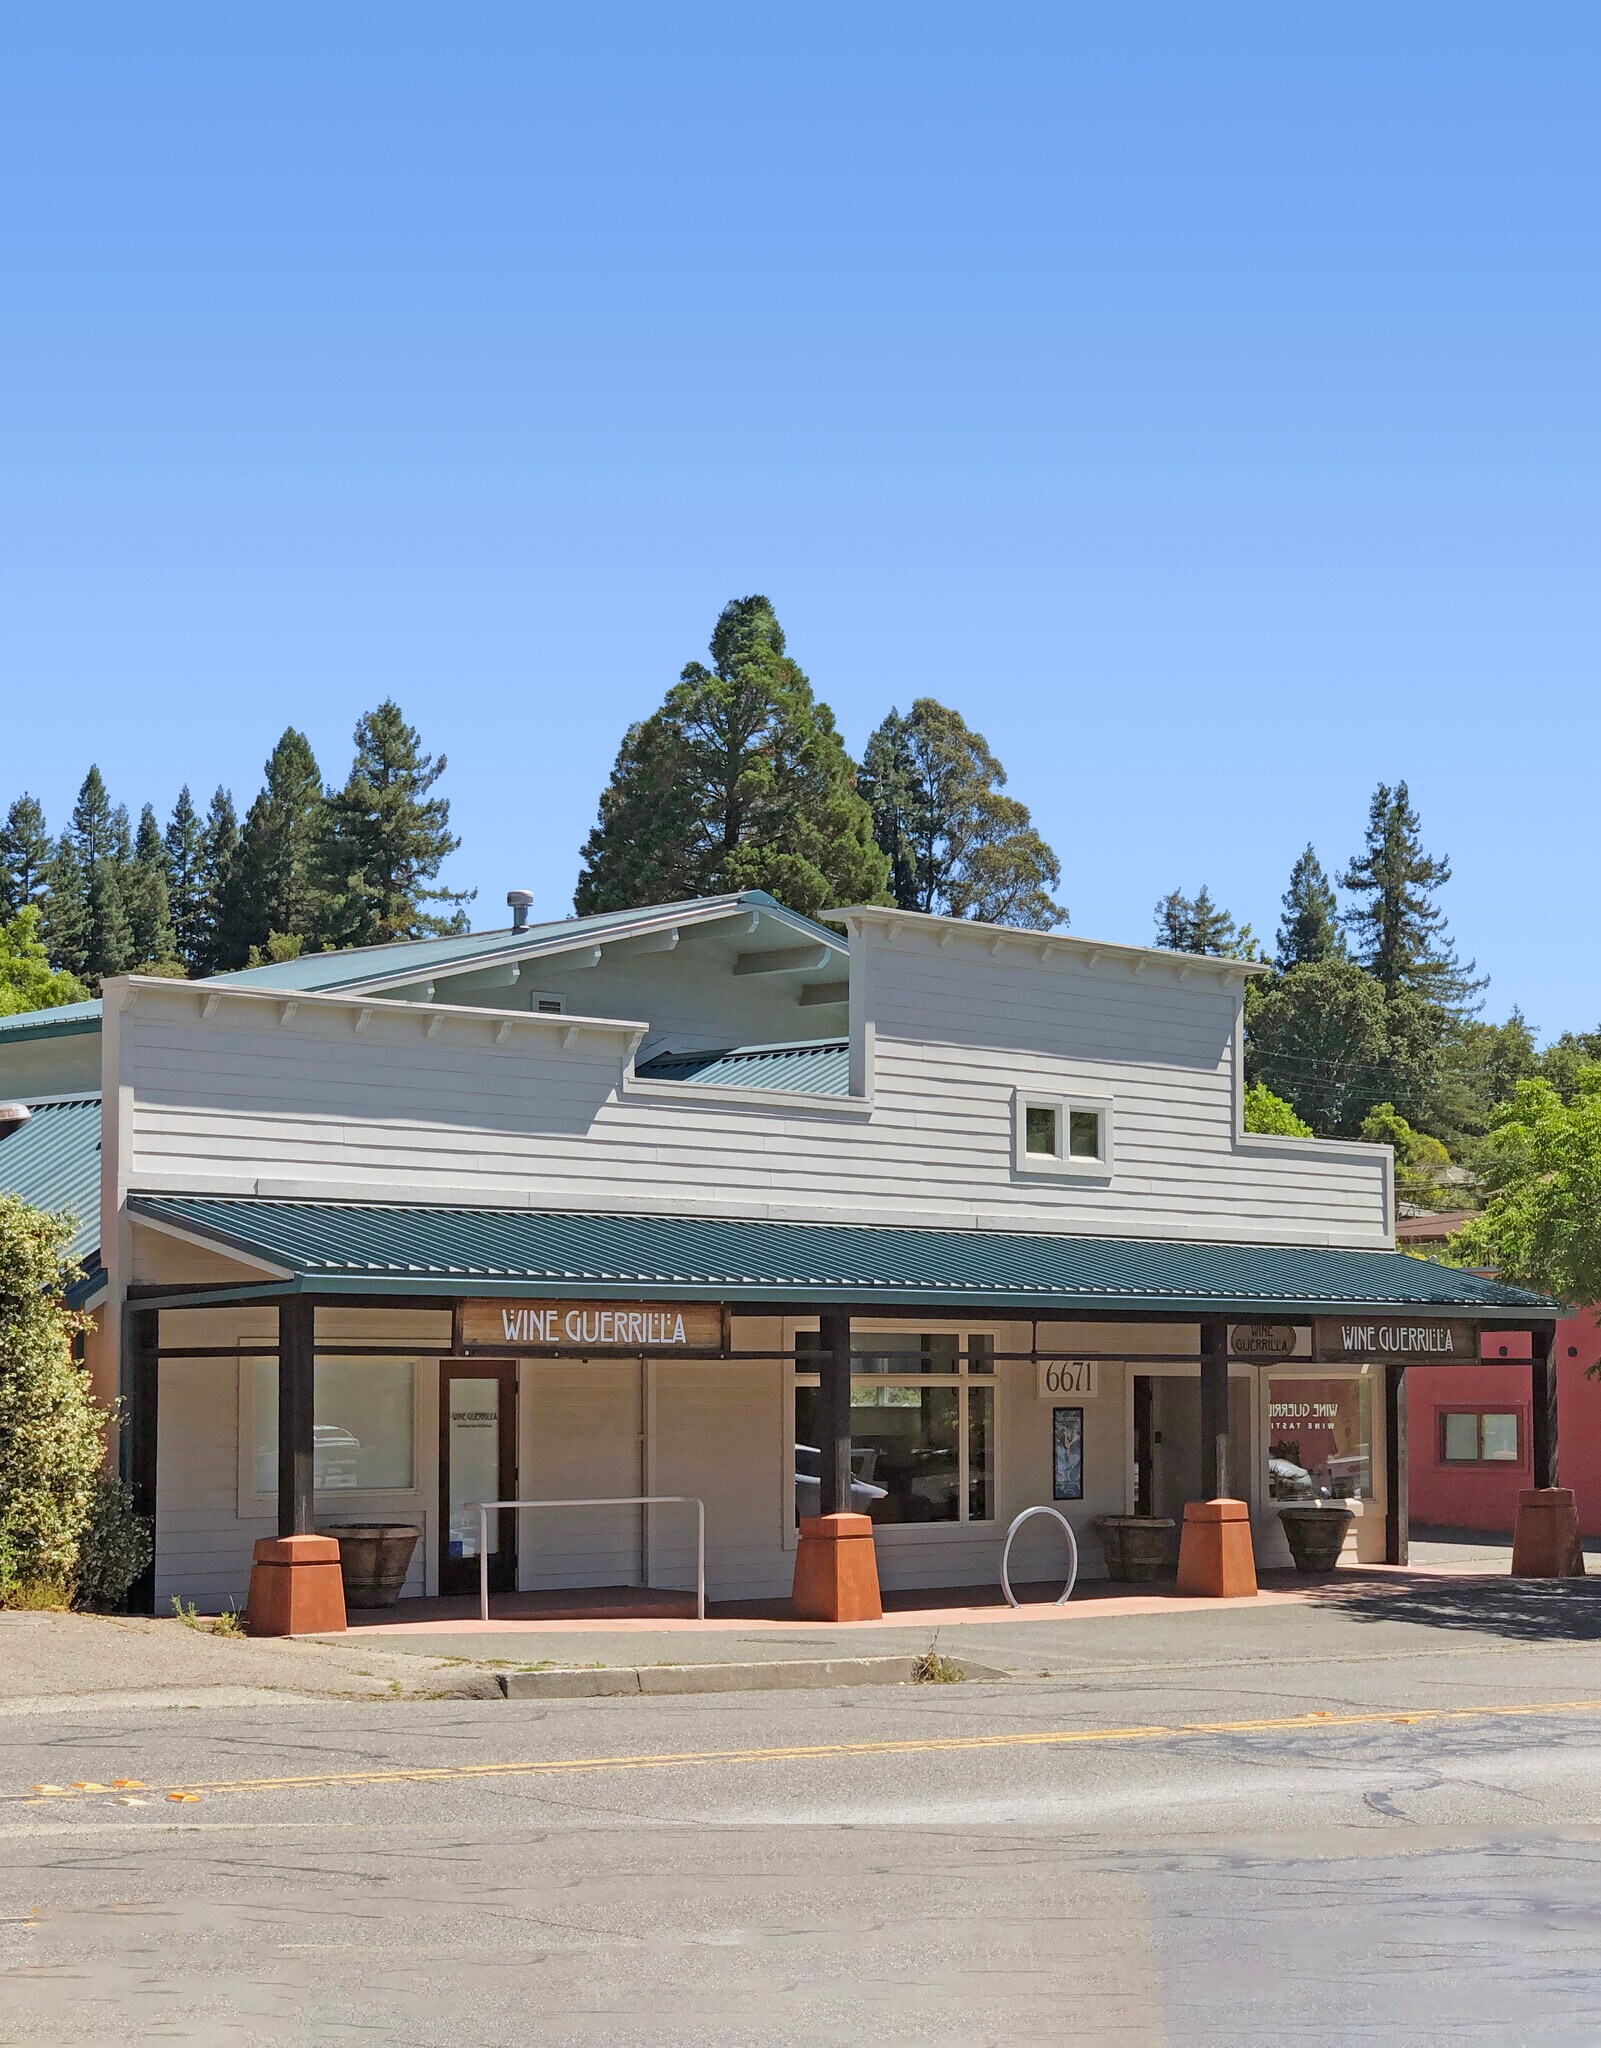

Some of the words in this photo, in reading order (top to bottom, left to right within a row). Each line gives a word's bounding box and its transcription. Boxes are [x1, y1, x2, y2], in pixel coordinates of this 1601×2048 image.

[502, 1309, 559, 1341] WINE
[564, 1310, 687, 1344] GUERRILLA
[1250, 1325, 1274, 1337] WINE
[1341, 1325, 1376, 1350] WINE
[1378, 1326, 1454, 1352] GUERRILLA
[1236, 1339, 1287, 1351] GUERRILLA
[1046, 1362, 1092, 1392] 6671
